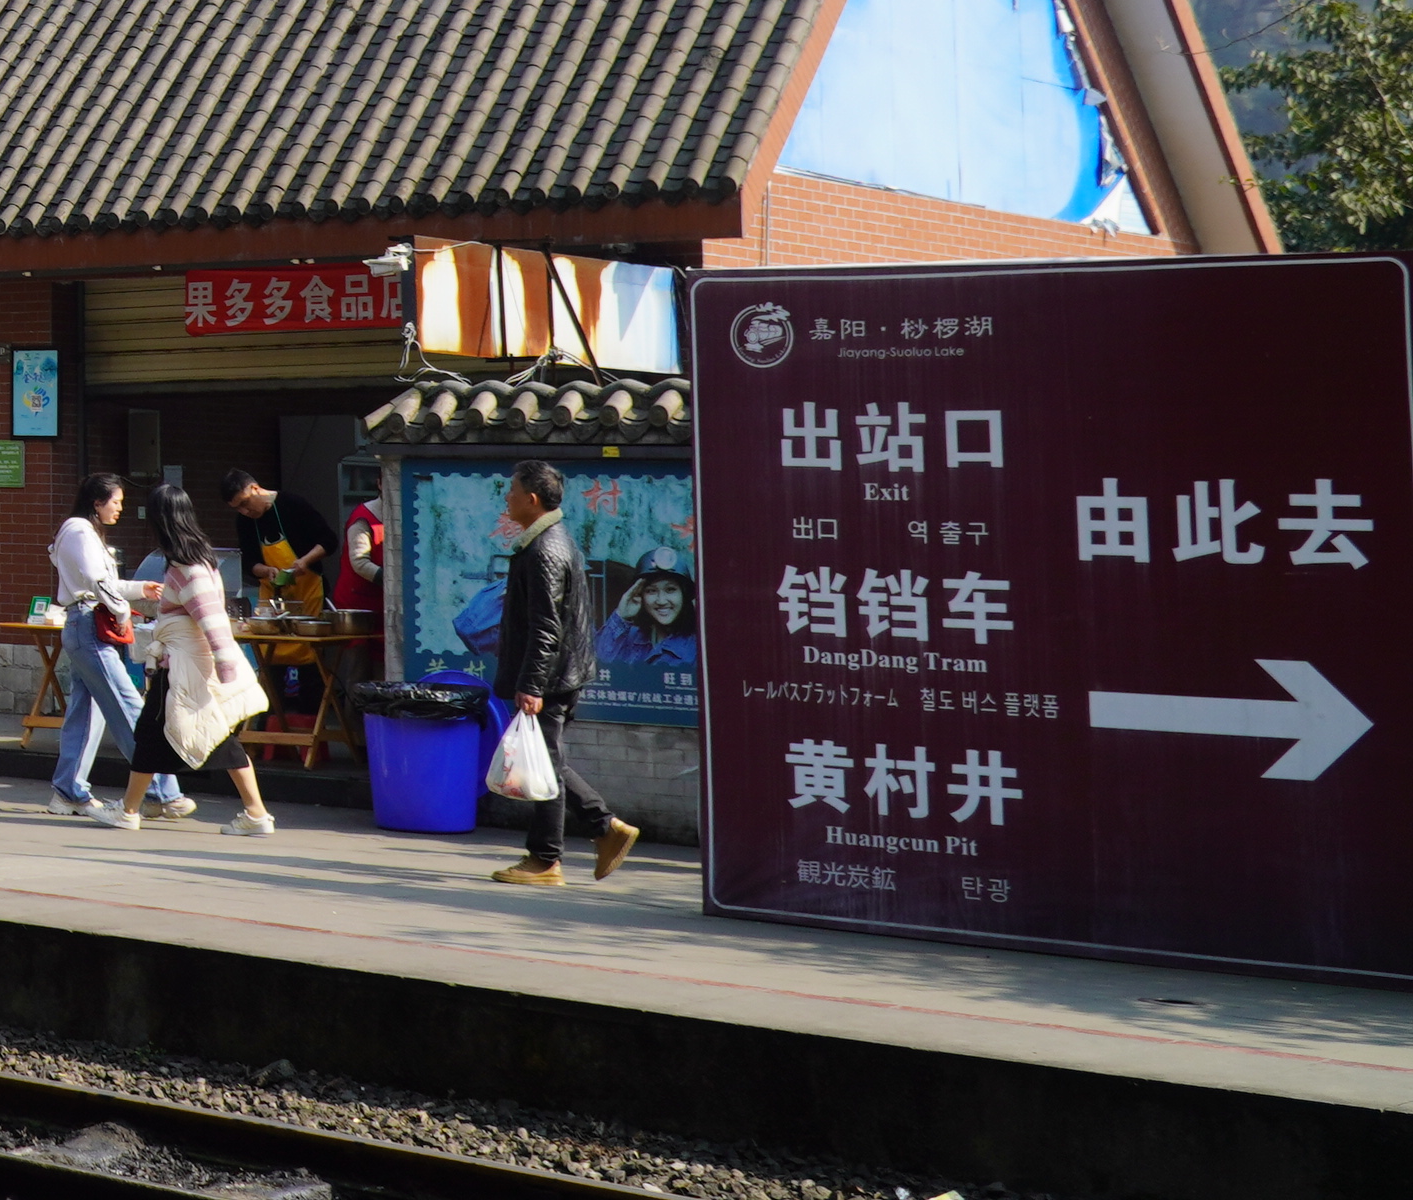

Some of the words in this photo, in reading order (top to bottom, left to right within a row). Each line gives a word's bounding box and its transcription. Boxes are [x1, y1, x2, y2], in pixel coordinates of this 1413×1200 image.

[838, 346, 931, 359] Jiayang-Suoluo
[935, 347, 965, 357] Lake
[780, 402, 1004, 472] 出站口
[863, 482, 910, 502] Exit
[792, 516, 839, 540] 出口
[907, 520, 928, 545] 역
[939, 520, 989, 546] 출구
[1075, 477, 1375, 570] 由此去
[776, 564, 1015, 645] 铛铛车
[803, 646, 919, 674] DangDang
[923, 652, 988, 674] Tram
[919, 687, 955, 712] 철도
[961, 691, 998, 714] 버스
[1004, 692, 1060, 719] 플랫폼
[784, 739, 1023, 827] 黄村井
[825, 825, 939, 855] Huangcun
[944, 835, 979, 857] Pit
[796, 859, 897, 891] 観光炭鉱
[961, 876, 1011, 903] 탄광
